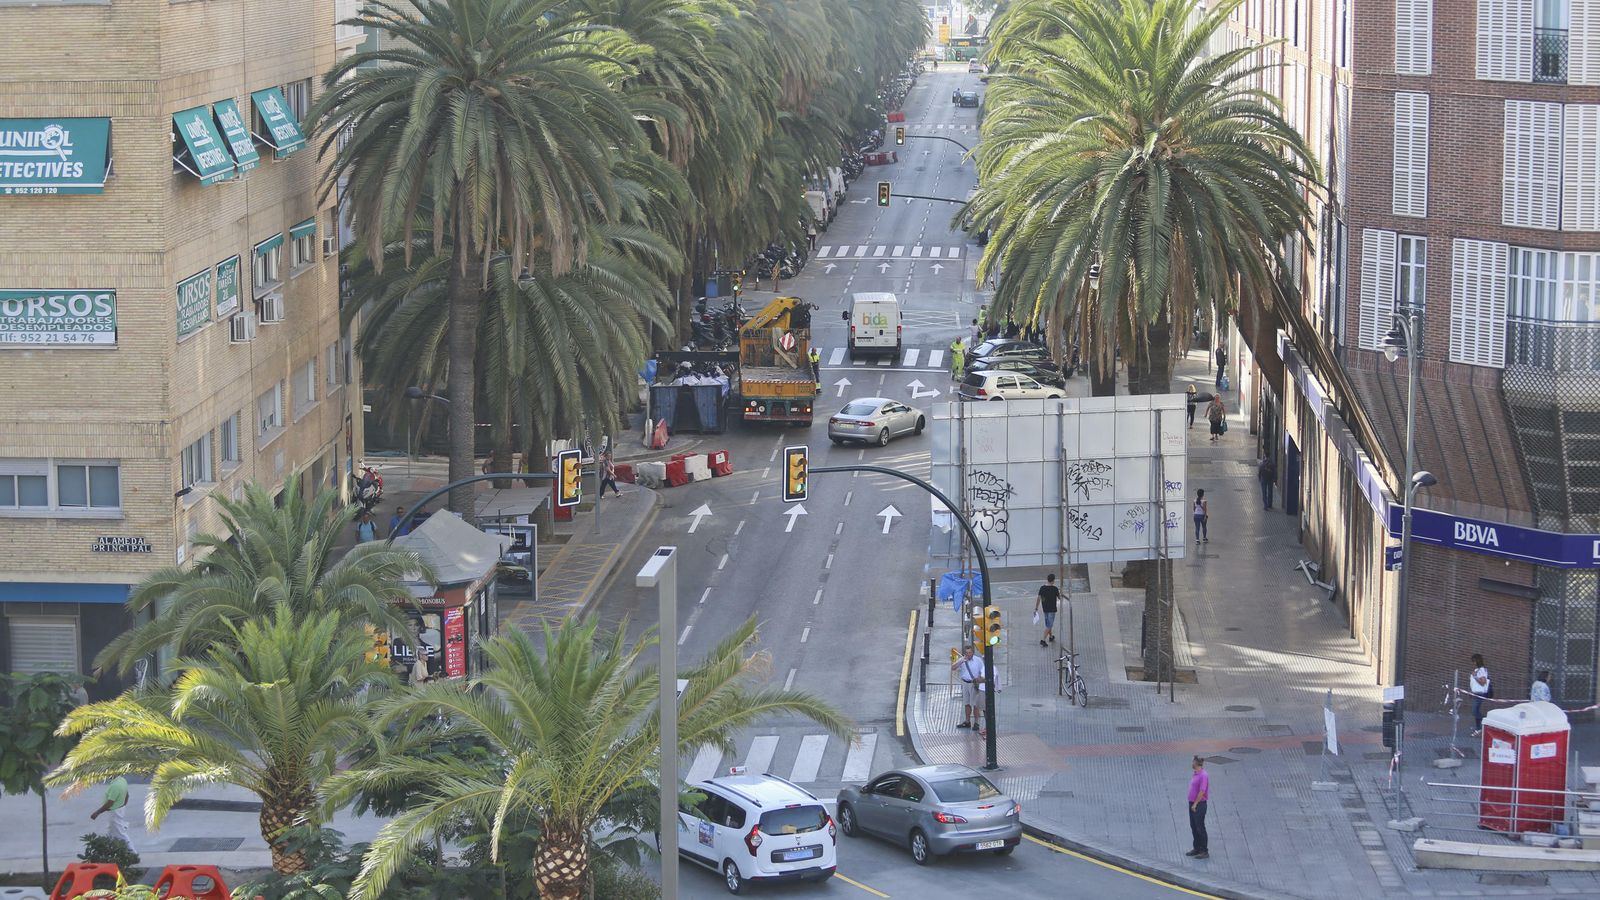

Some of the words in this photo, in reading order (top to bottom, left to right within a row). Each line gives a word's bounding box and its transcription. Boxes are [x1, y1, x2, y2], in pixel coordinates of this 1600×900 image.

[862, 312, 888, 326] bida
[20, 333, 41, 342] 952
[45, 334, 60, 342] 21
[63, 334, 77, 342] 54
[81, 334, 94, 342] 76
[1453, 521, 1499, 546] BBVA
[99, 537, 144, 545] ALAMEDA
[92, 545, 151, 553] PRINCIPAL
